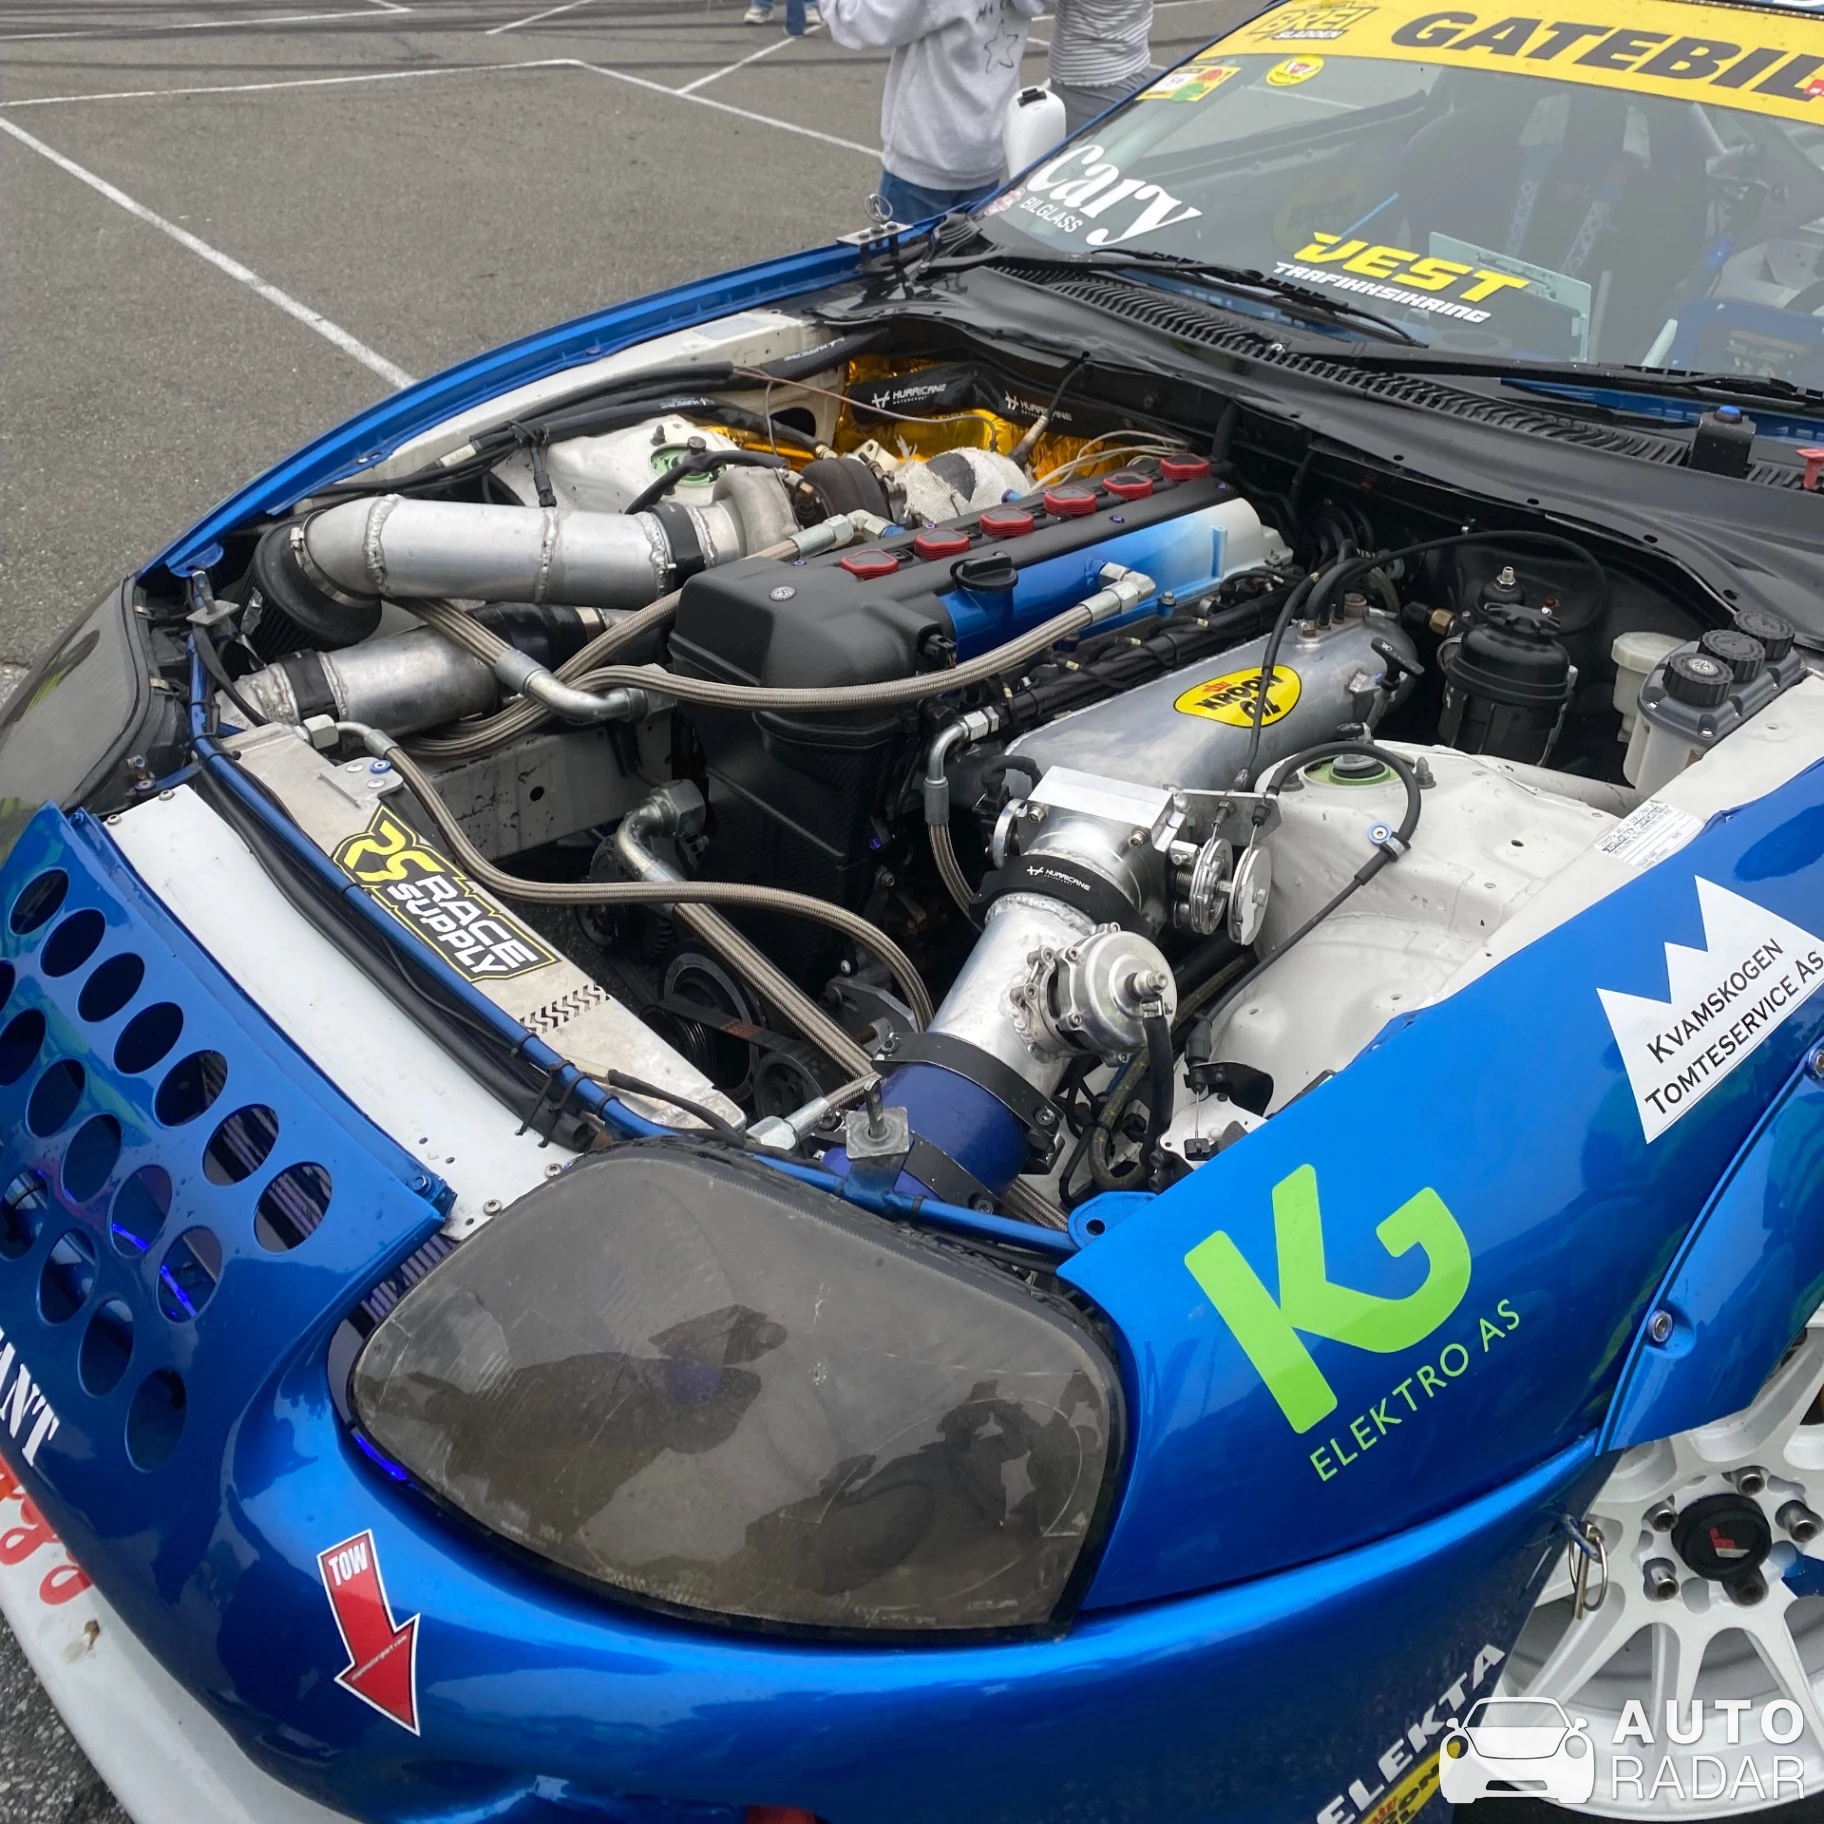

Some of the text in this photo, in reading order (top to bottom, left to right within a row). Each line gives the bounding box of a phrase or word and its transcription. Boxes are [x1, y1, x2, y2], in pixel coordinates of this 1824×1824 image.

[1391, 11, 1824, 101] GATEBIL
[1019, 197, 1083, 233] BILGLASS
[893, 383, 947, 399] HURRICANE
[1020, 400, 1072, 421] HURRIANE
[415, 874, 539, 969] RACE
[1045, 869, 1091, 891] HURRICANE
[387, 883, 509, 974] SUPPLY
[1644, 951, 1824, 1114] TOMTESERVICE AS
[1647, 938, 1783, 1063] KVAMSKOGEN
[1309, 1299, 1520, 1481] ELEKTRO AS
[328, 1541, 368, 1586] TOW
[1317, 1643, 1506, 1824] ELEKTA
